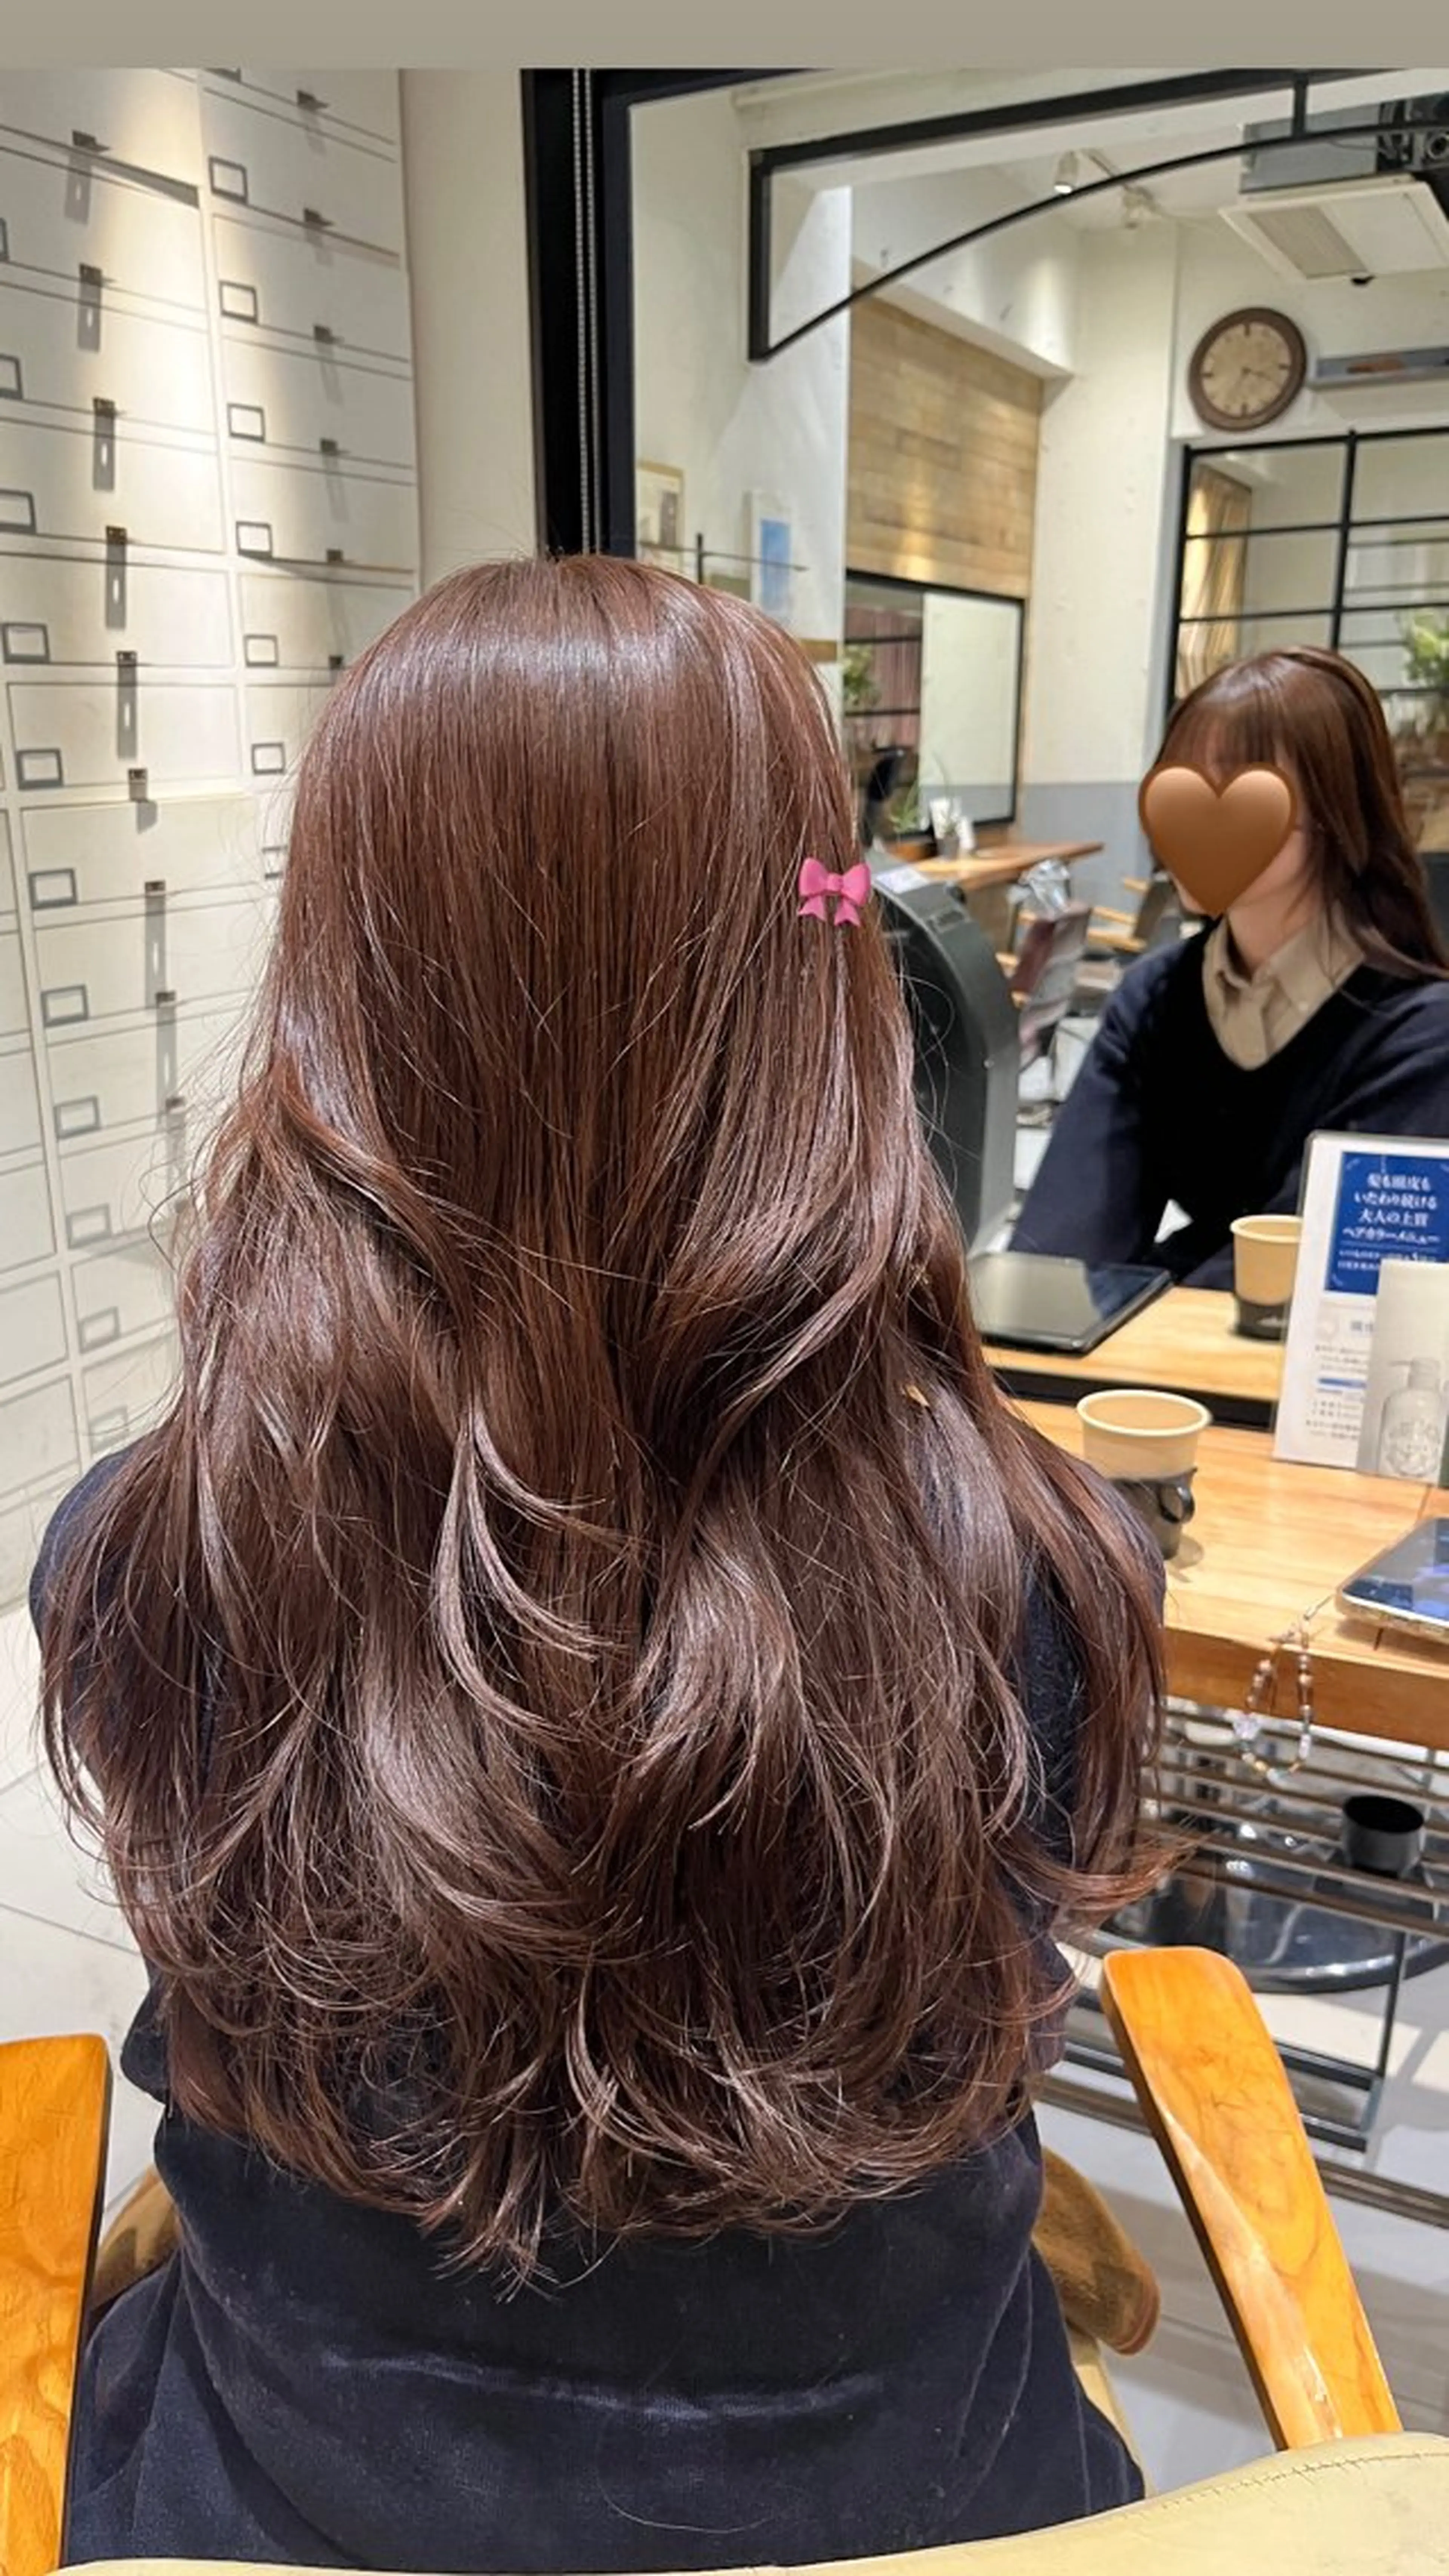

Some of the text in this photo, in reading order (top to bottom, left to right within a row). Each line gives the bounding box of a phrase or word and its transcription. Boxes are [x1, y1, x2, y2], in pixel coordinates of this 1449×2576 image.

[1354, 1191, 1437, 1209] いたわり続ける
[1342, 1227, 1440, 1244] ヘアカラーメニュー
